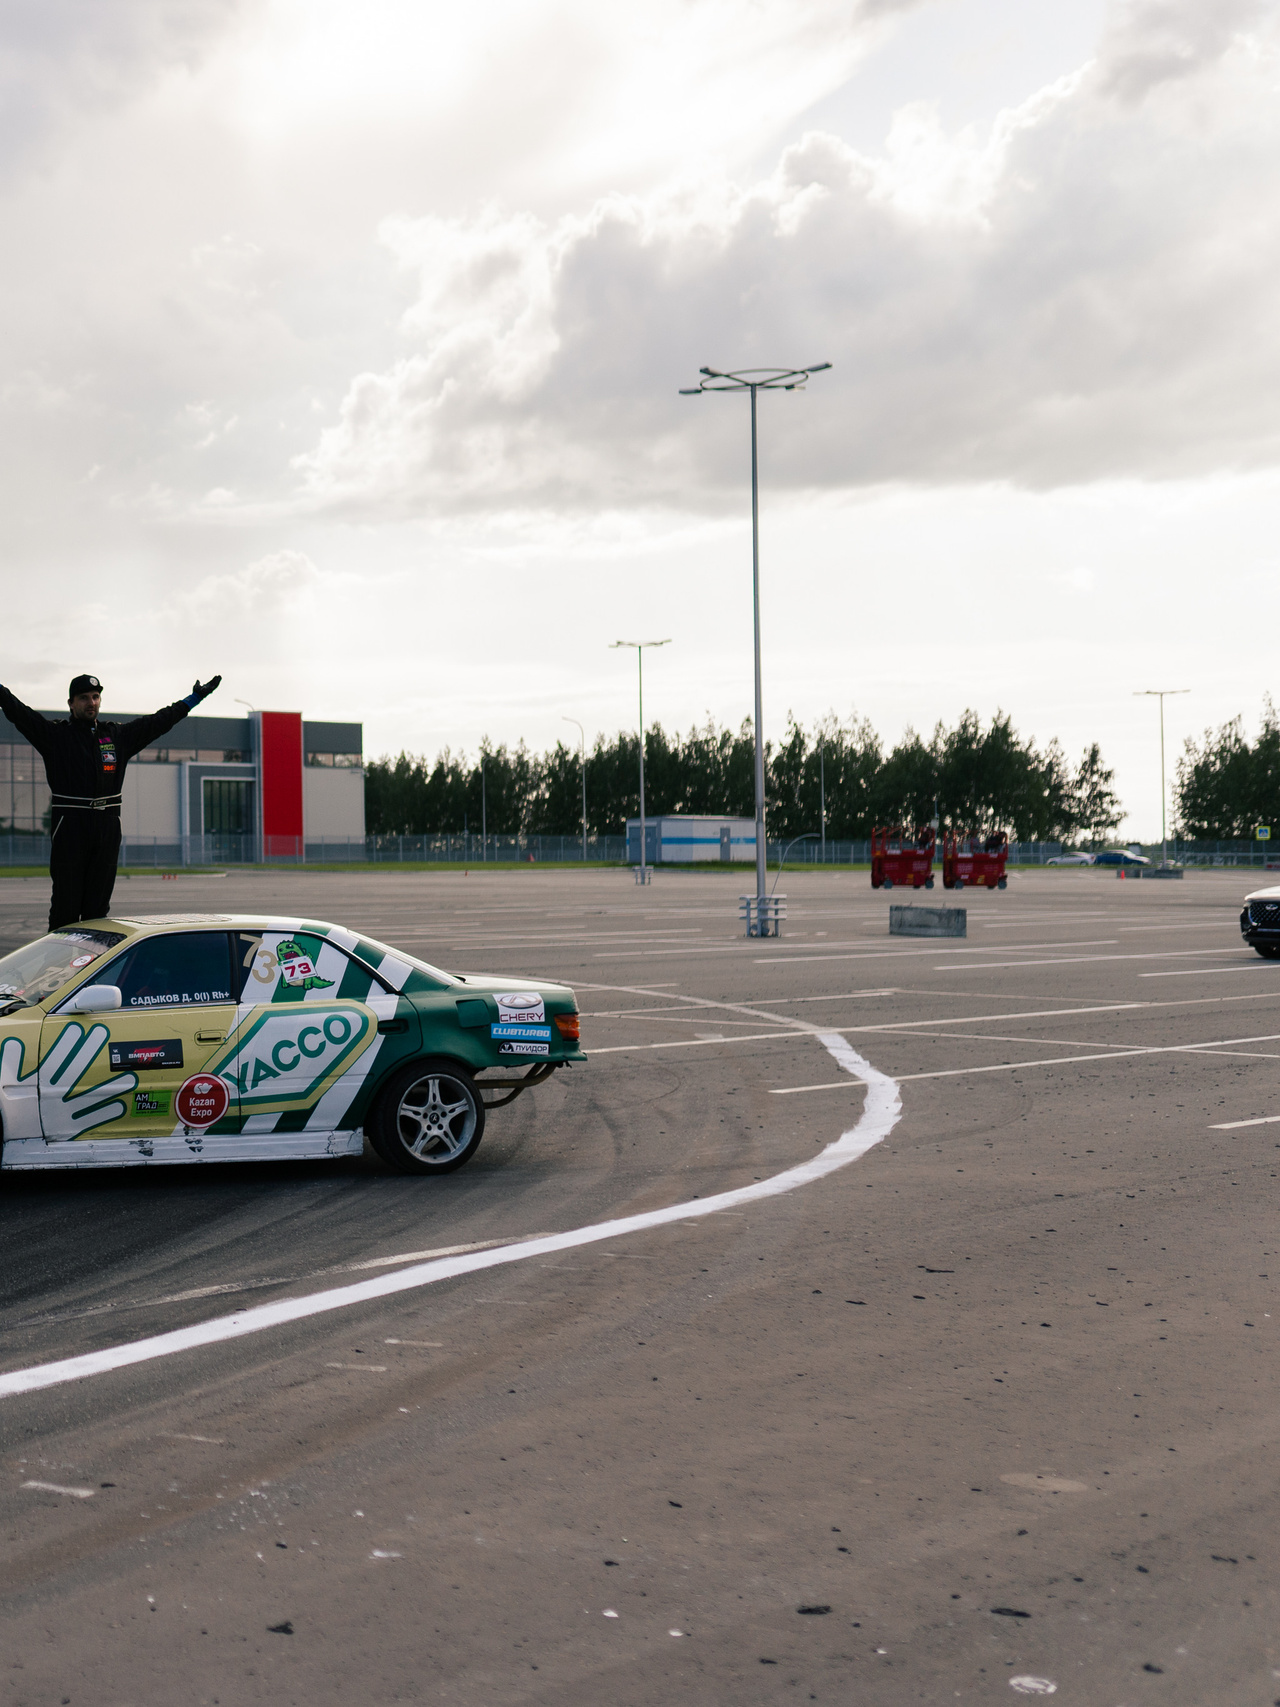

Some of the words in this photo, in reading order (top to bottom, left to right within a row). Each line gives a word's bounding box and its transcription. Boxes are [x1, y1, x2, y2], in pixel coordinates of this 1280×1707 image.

[240, 933, 278, 985] 73
[284, 962, 312, 978] 73
[130, 994, 180, 1005] САДЫКОВ
[182, 993, 192, 1003] Д.
[212, 991, 230, 1000] Rh+
[500, 1012, 544, 1022] CHERY
[493, 1027, 550, 1037] CLUBTURBO
[128, 1051, 166, 1059] ВМПАВТО
[221, 1014, 352, 1095] YACCO
[135, 1093, 149, 1101] АМ
[189, 1097, 215, 1107] Kazan
[136, 1101, 157, 1110] ГРАД
[190, 1107, 213, 1118] Expo
